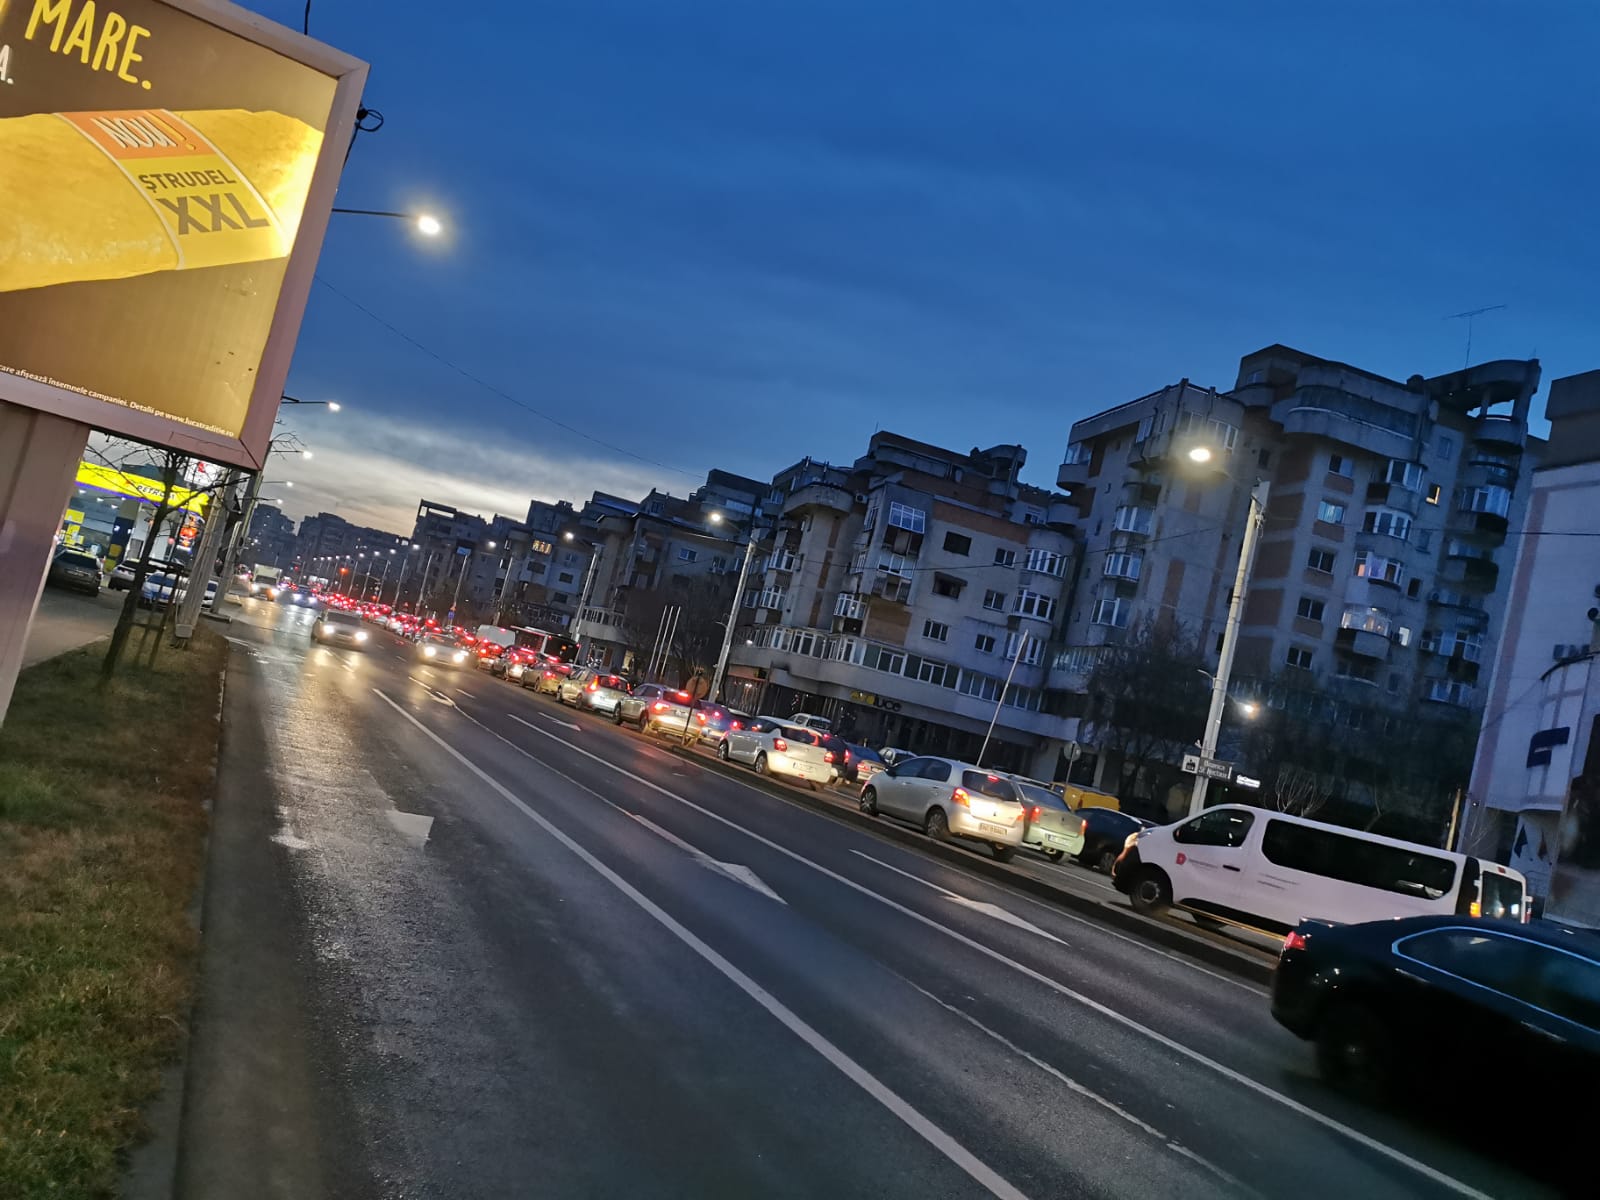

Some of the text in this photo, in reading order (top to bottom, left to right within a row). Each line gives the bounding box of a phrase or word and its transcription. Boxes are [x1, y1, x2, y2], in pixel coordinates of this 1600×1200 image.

[25, 0, 151, 90] MARE.
[156, 192, 270, 235] XXL
[154, 409, 165, 418] pe
